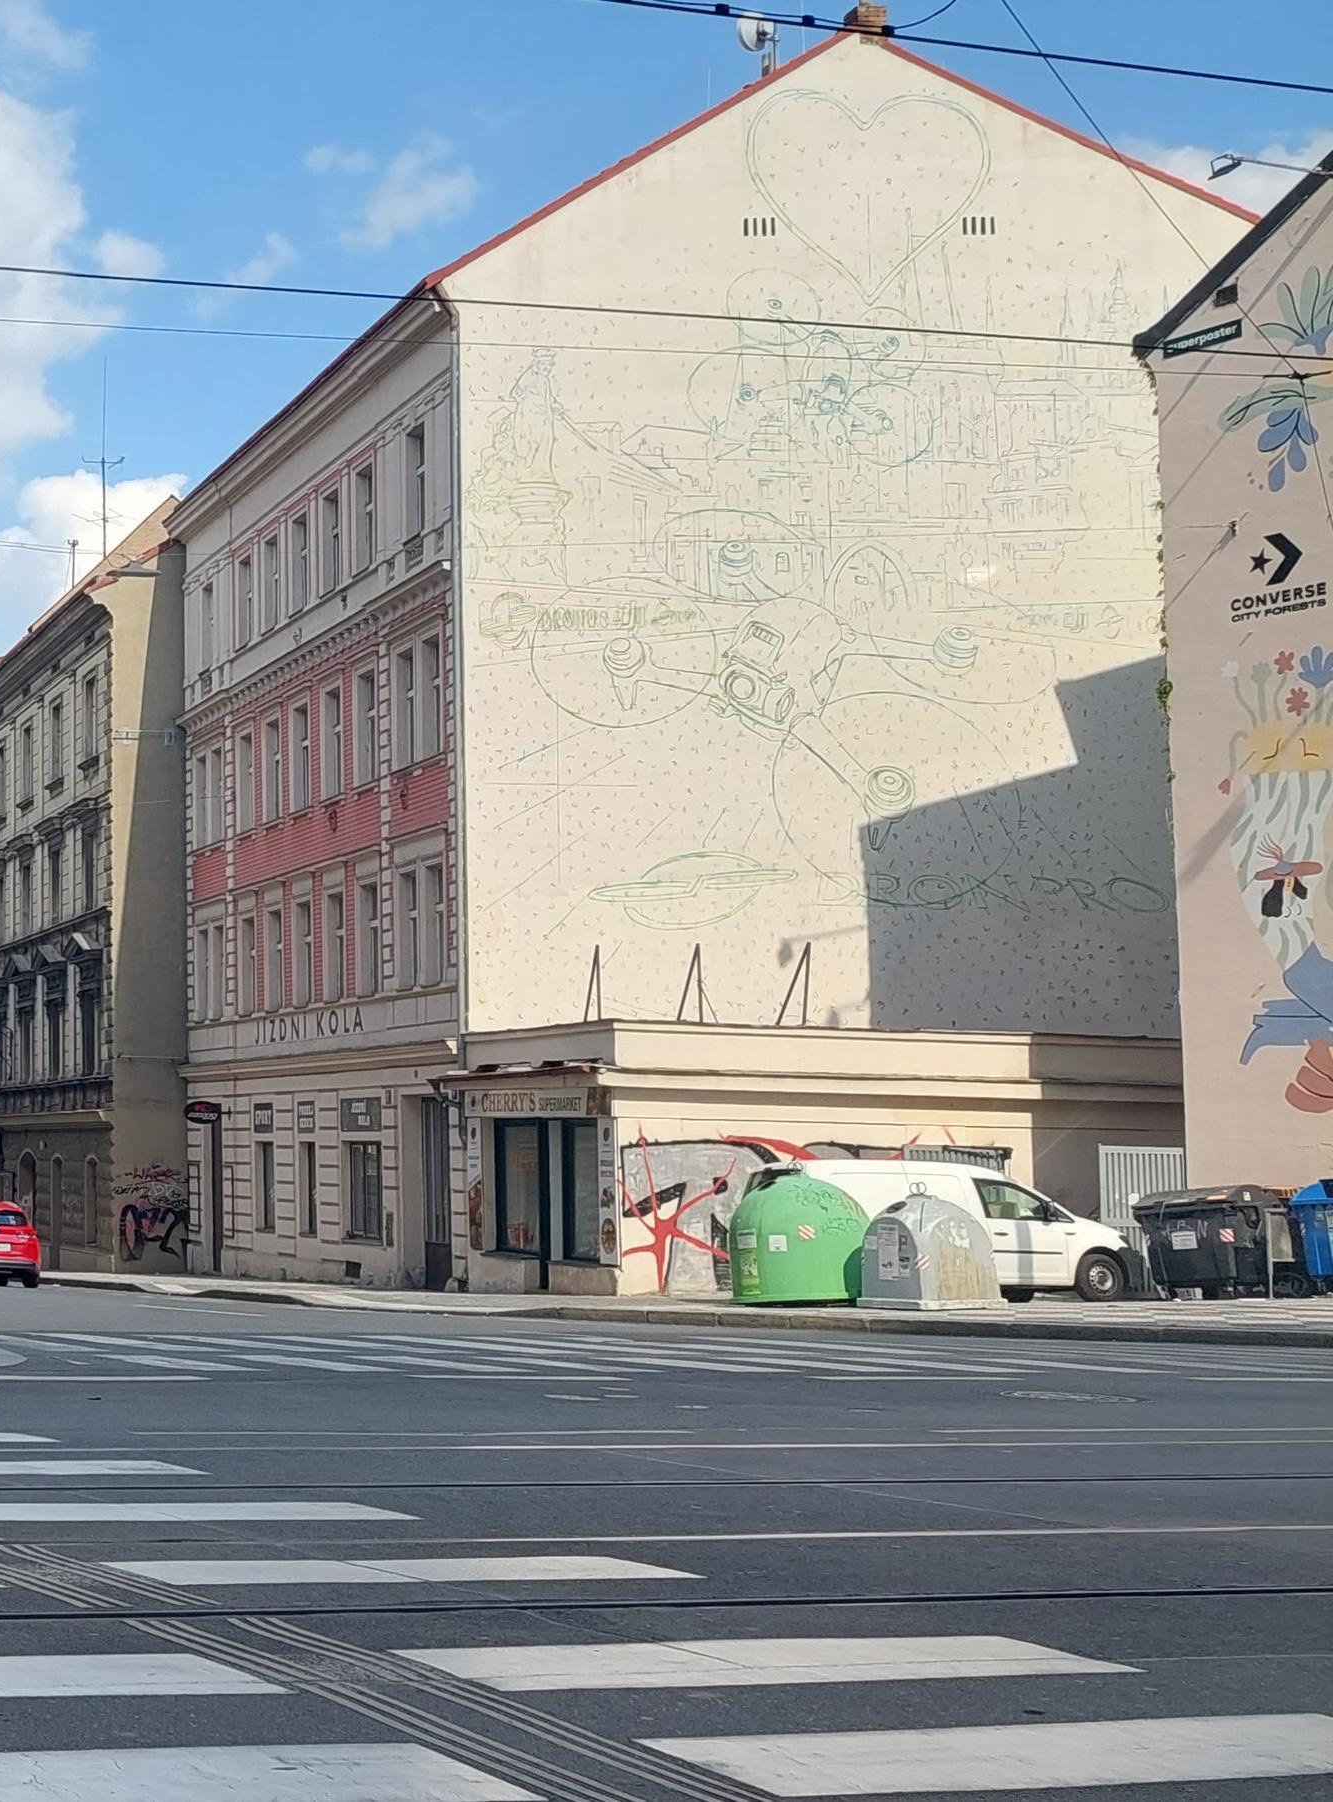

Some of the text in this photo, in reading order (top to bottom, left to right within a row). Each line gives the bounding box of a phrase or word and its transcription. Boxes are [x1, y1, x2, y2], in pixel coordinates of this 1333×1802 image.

[1231, 582, 1327, 612] CONVERSE
[1231, 598, 1327, 623] CITY FORESTS
[316, 1006, 364, 1037] KOLA
[482, 1092, 582, 1112] CHERRY'S SUPERMARKET
